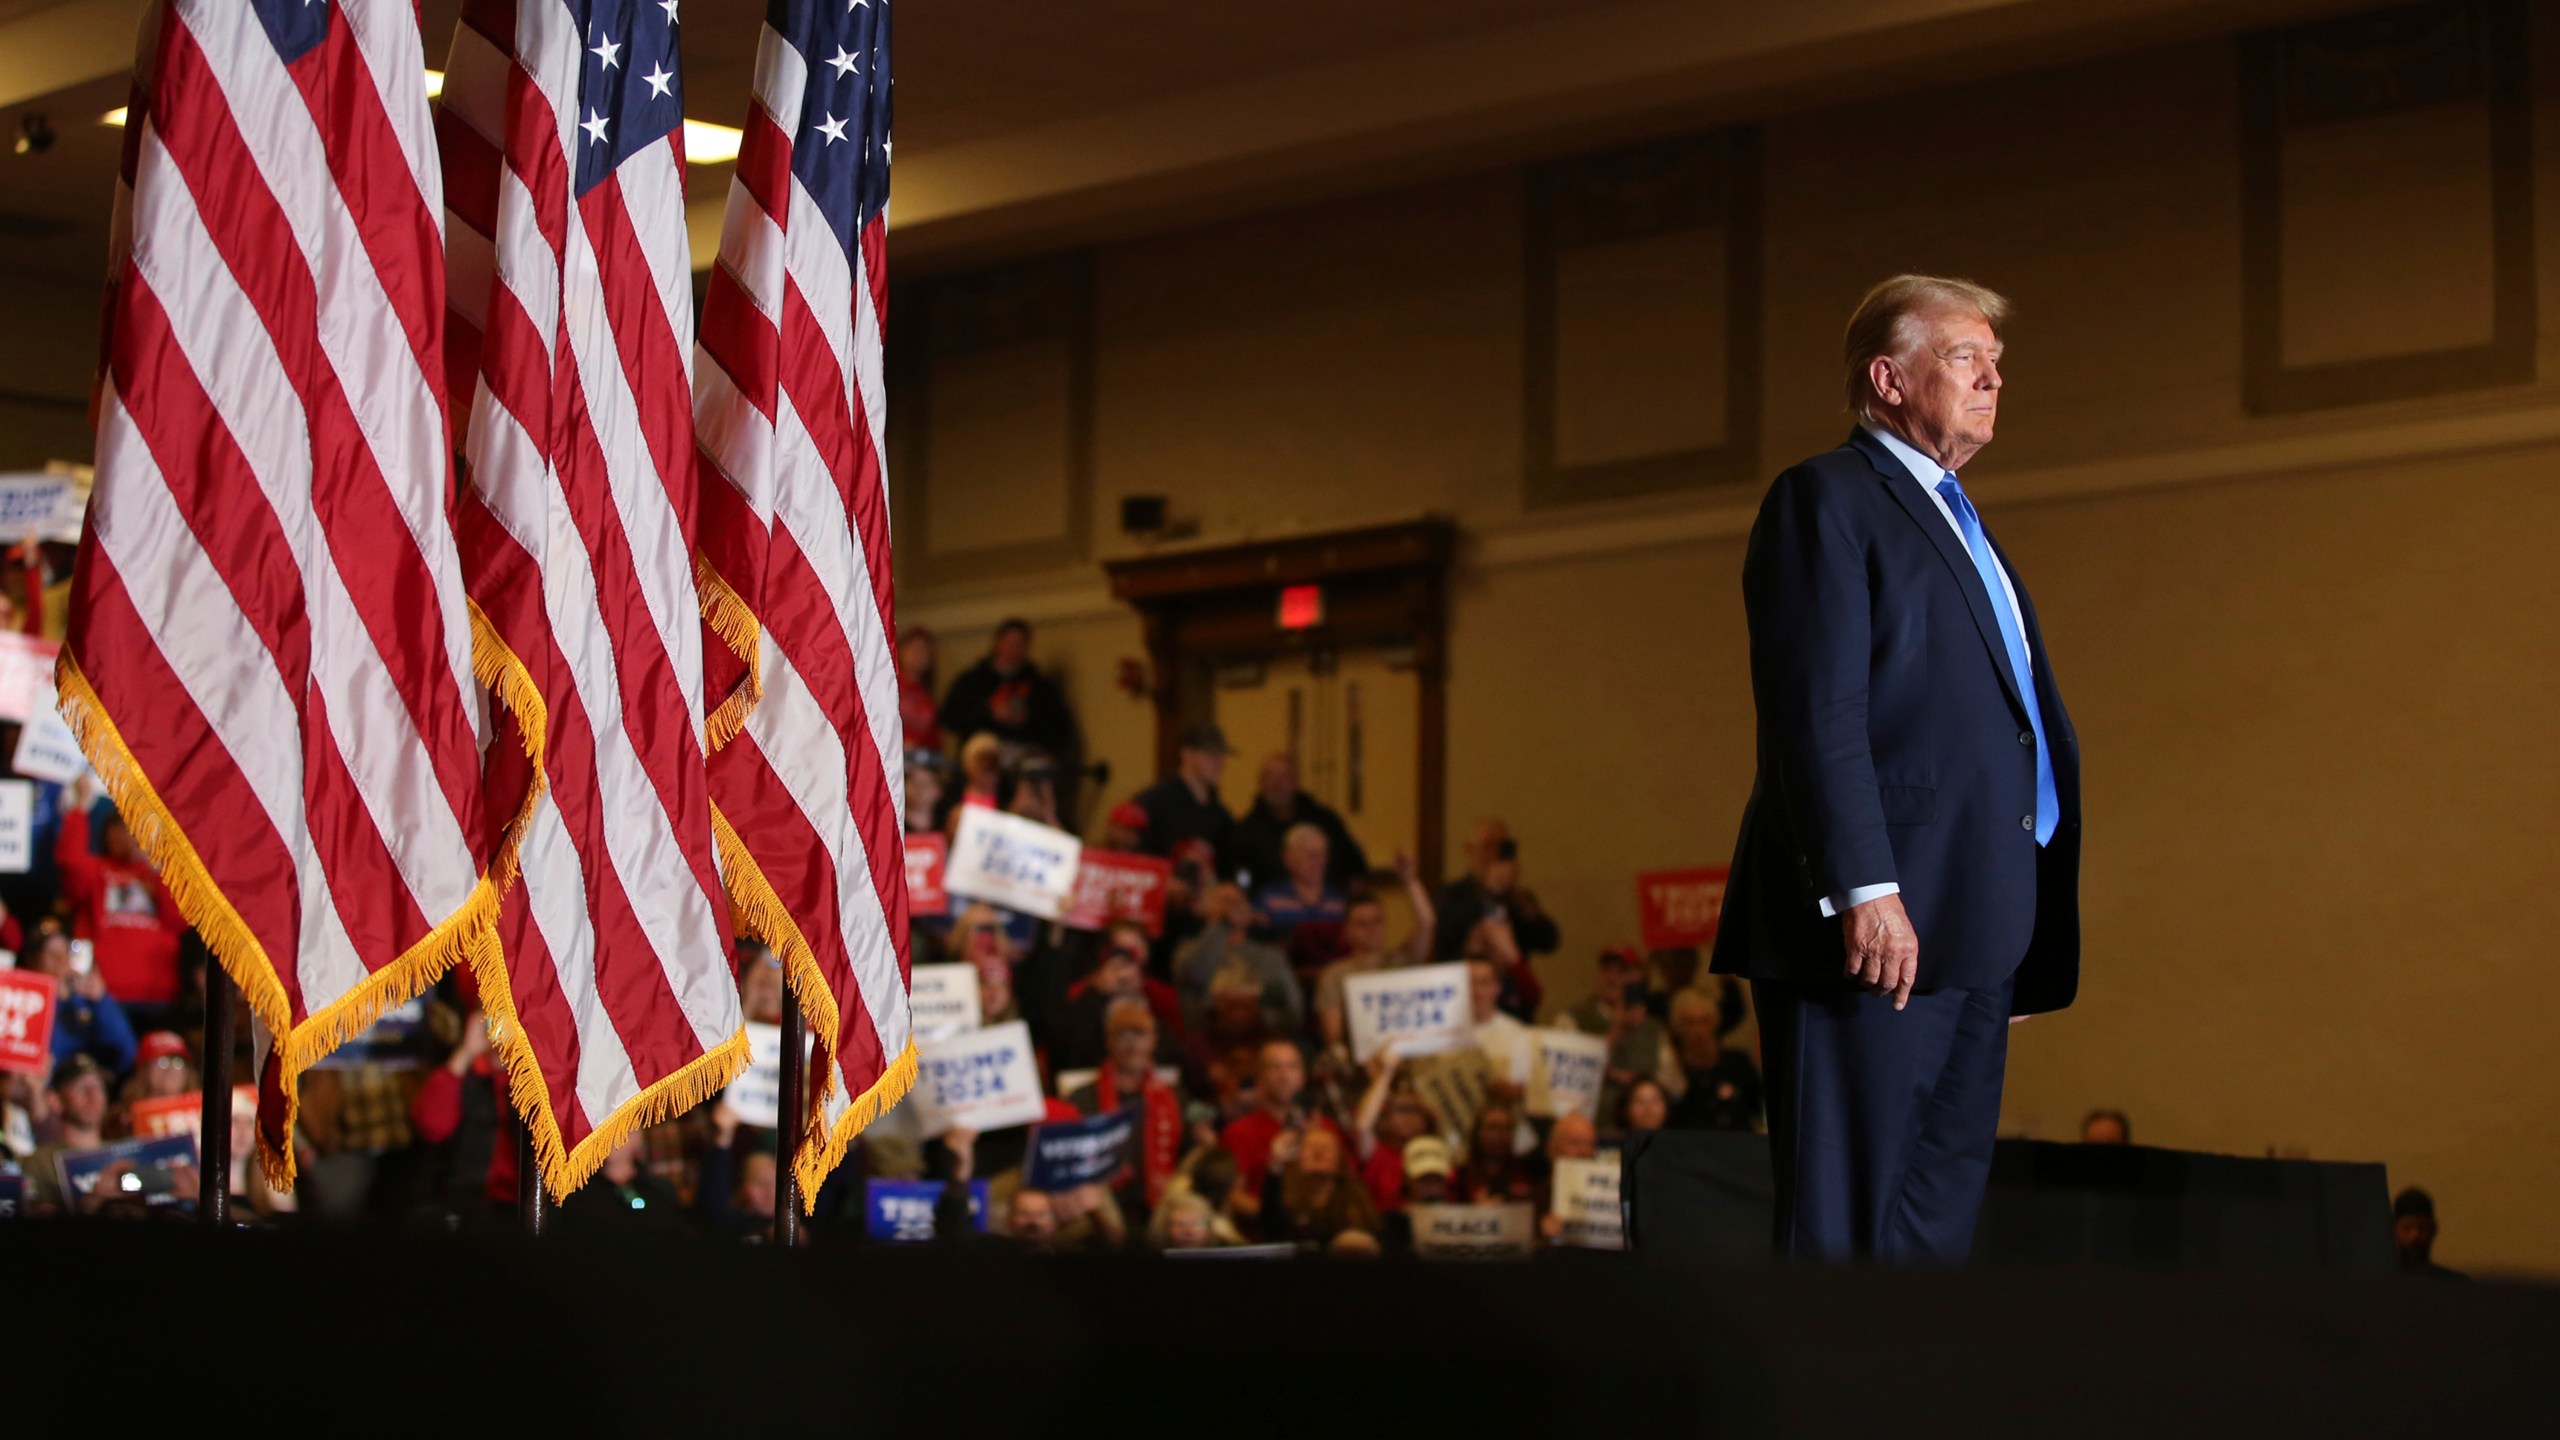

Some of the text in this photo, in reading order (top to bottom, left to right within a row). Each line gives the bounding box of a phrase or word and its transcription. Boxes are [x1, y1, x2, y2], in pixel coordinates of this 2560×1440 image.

[1361, 985, 1457, 1011] TRUMP
[1376, 1007, 1446, 1033] 2024
[918, 1047, 1016, 1084] TRUMP
[934, 1073, 1006, 1106] 2024
